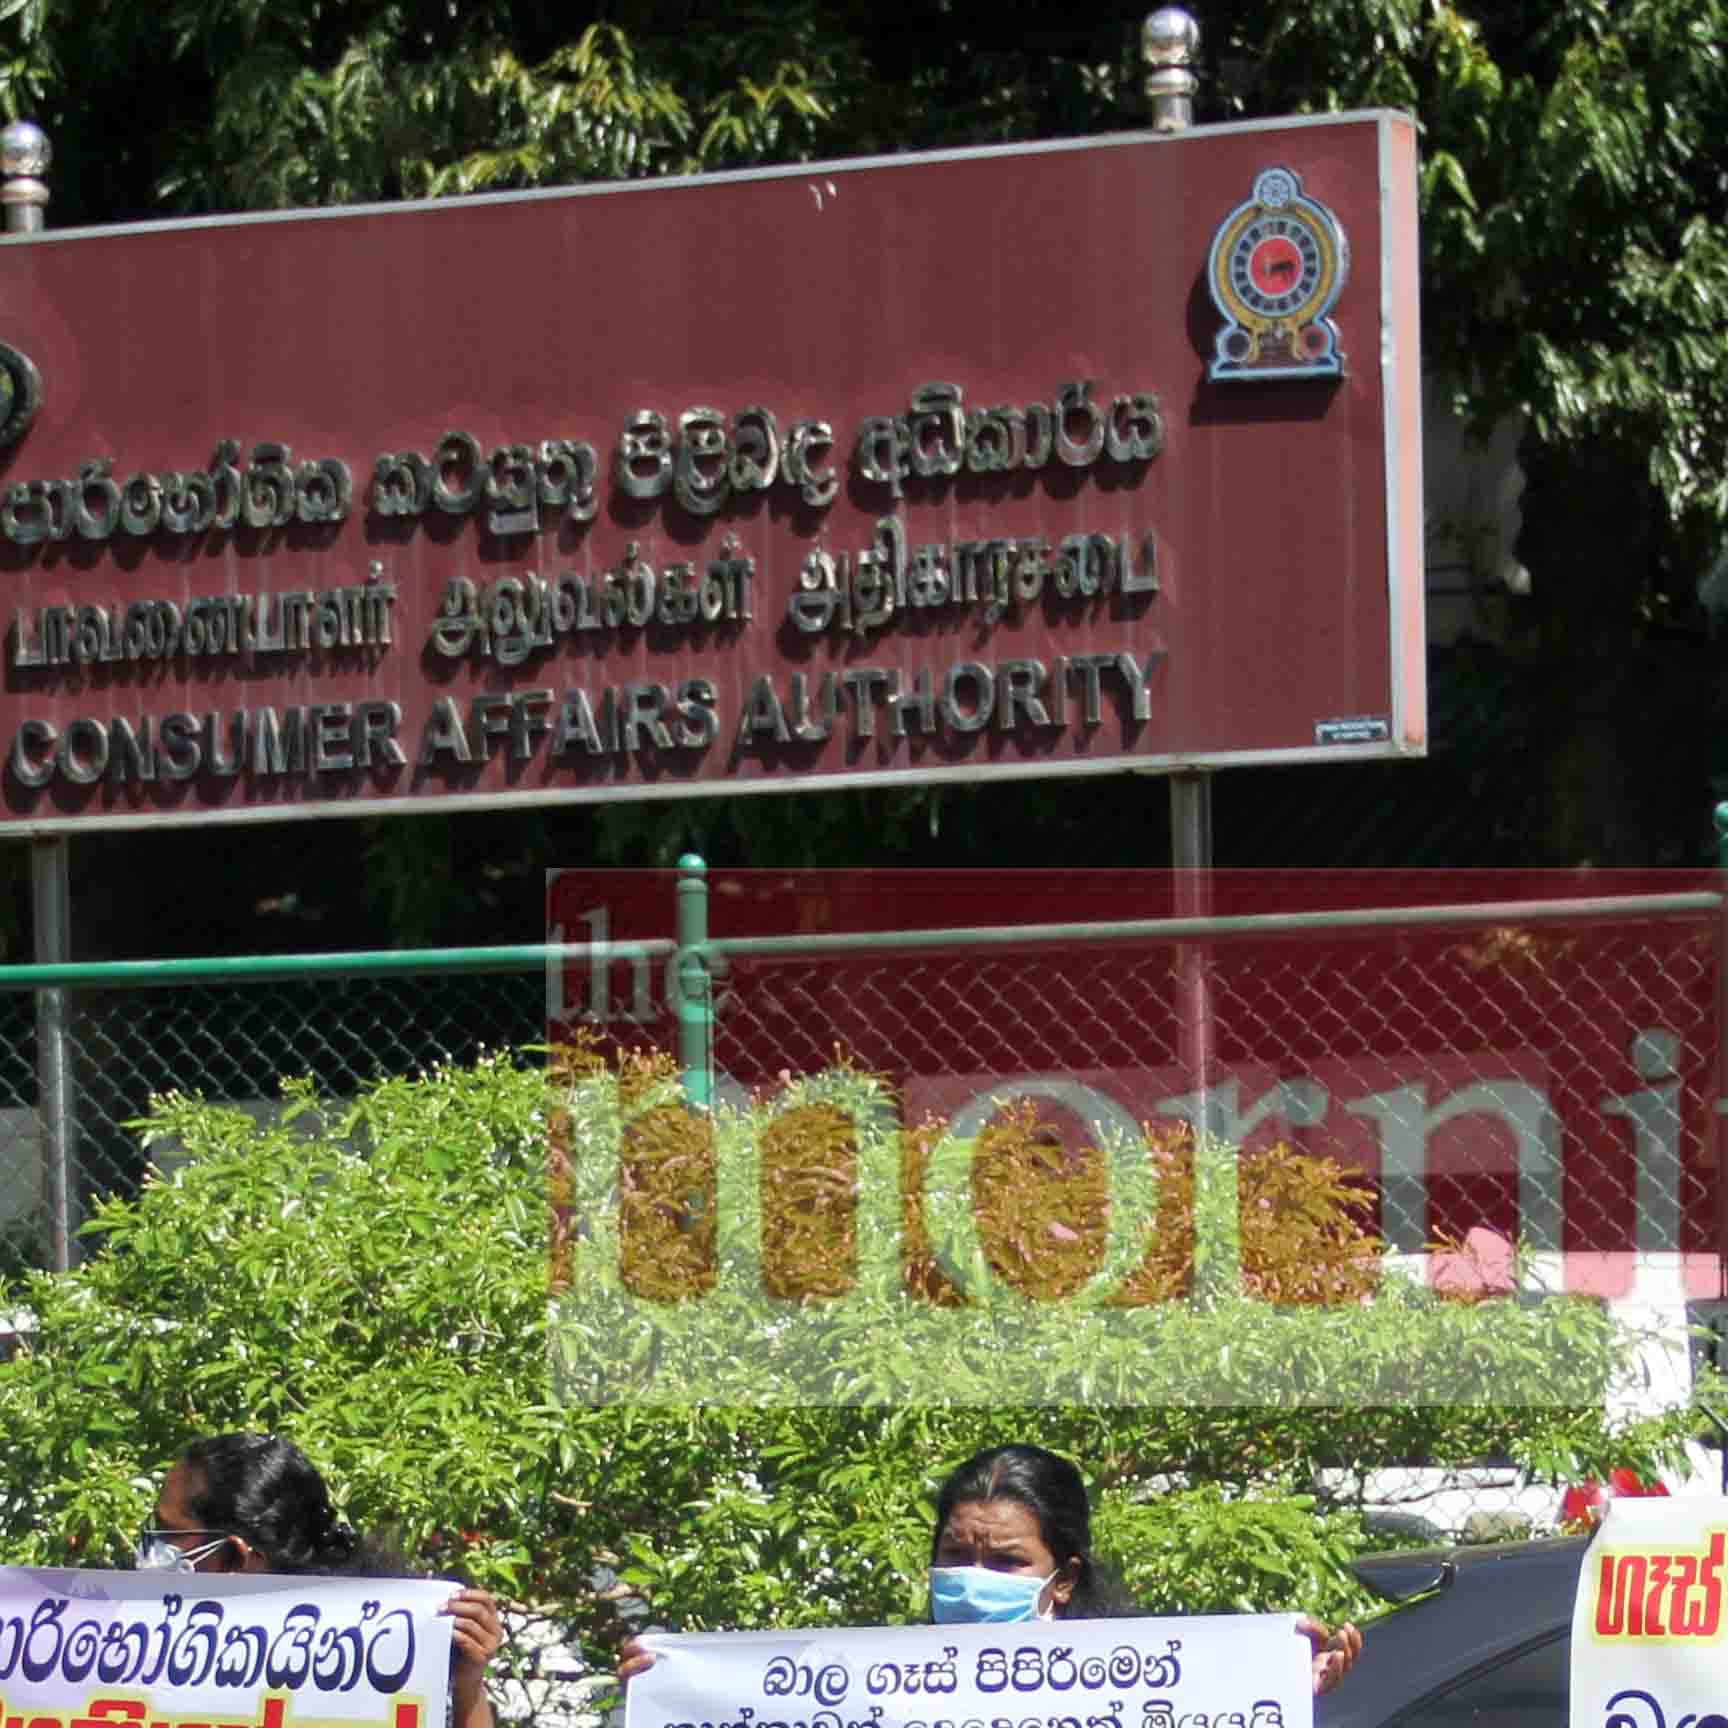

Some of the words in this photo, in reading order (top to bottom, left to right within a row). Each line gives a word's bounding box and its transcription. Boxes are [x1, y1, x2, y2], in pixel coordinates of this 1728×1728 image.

[373, 432, 598, 535] කටයුතු
[619, 406, 839, 515] පිළිබඳ
[433, 530, 754, 665] அலுவல்கள்
[13, 700, 407, 787] CONSUMER
[421, 679, 719, 764] AFFAIRS
[737, 651, 1166, 746] AUTHORITY
[1594, 1533, 1724, 1636] ගෑස්
[762, 1657, 849, 1707] බාල
[866, 1647, 958, 1696] ගෑස්
